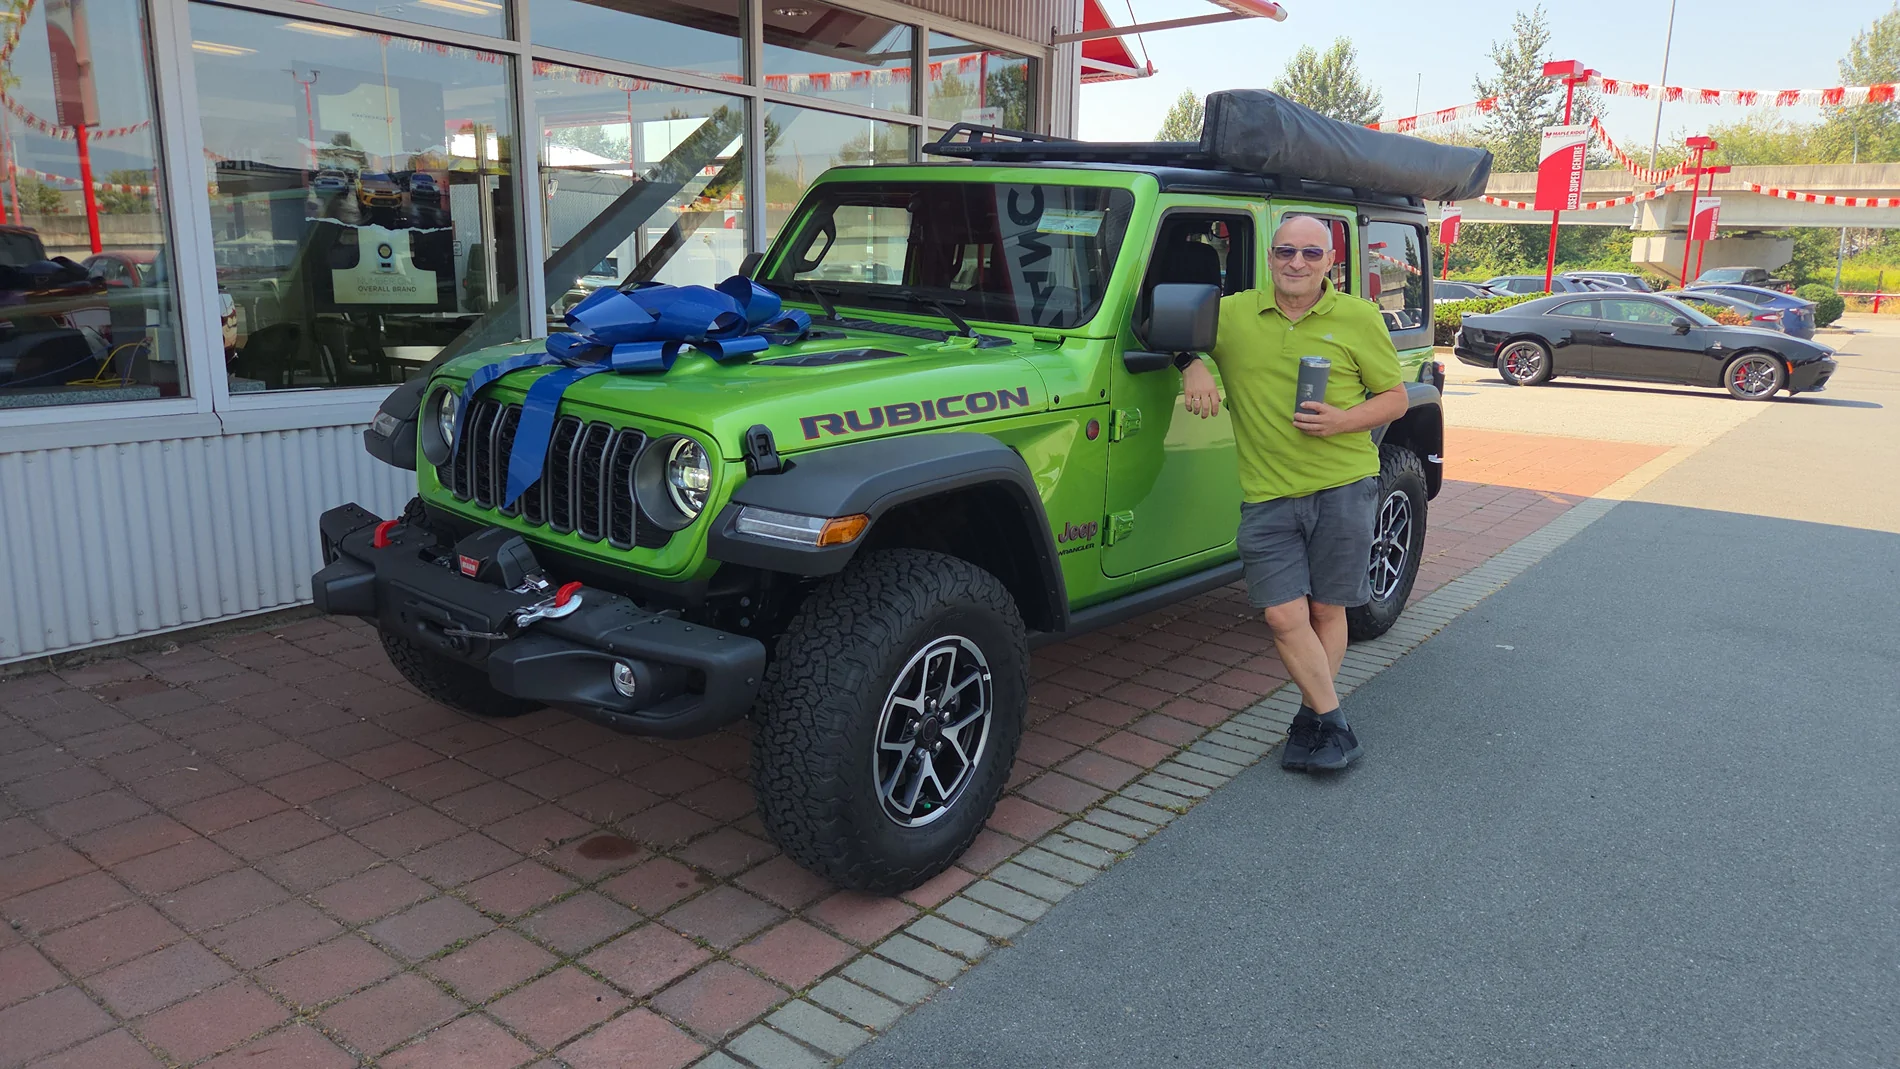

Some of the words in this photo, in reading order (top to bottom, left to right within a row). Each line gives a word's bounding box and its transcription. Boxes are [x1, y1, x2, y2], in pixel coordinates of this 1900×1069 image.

[1572, 146, 1584, 170] CENTRE
[1569, 171, 1581, 192] SUPER
[1567, 192, 1578, 210] USED
[357, 285, 391, 293] OVERALL
[799, 386, 1030, 440] RUBICON
[1058, 521, 1098, 543] Jeep
[1058, 542, 1095, 556] WRANGLER
